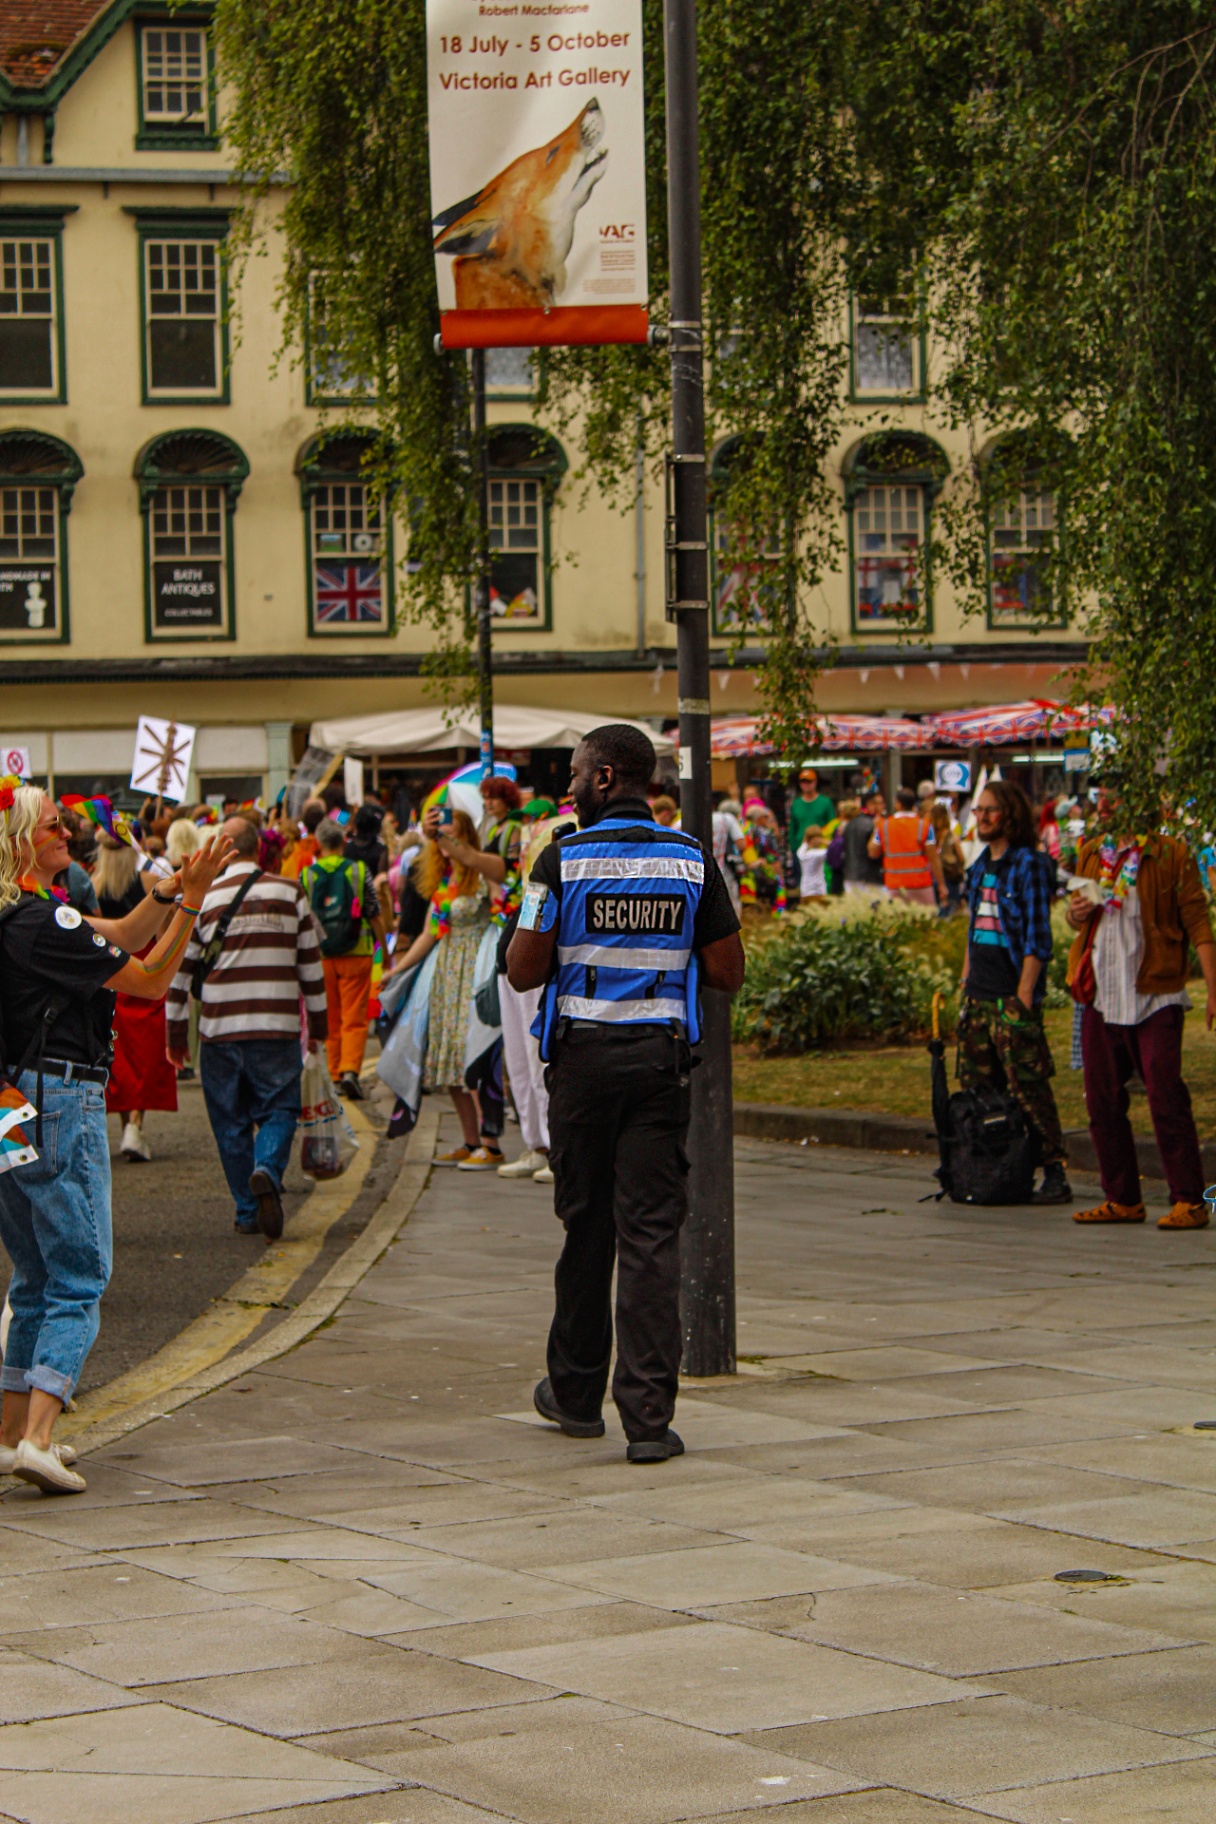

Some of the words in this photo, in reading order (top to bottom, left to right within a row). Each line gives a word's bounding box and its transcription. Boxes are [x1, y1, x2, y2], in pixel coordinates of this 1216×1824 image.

[479, 5, 518, 17] Robert
[521, 4, 590, 16] Macfarlane
[440, 35, 462, 54] 18
[469, 35, 509, 57] July
[529, 35, 541, 53] 5
[547, 31, 631, 52] October
[439, 72, 518, 90] Victoria
[524, 72, 552, 89] Art
[558, 68, 631, 87] Gallery
[173, 569, 203, 581] BATH
[161, 582, 216, 597] ANTIQUES
[593, 899, 682, 930] SECURITY
